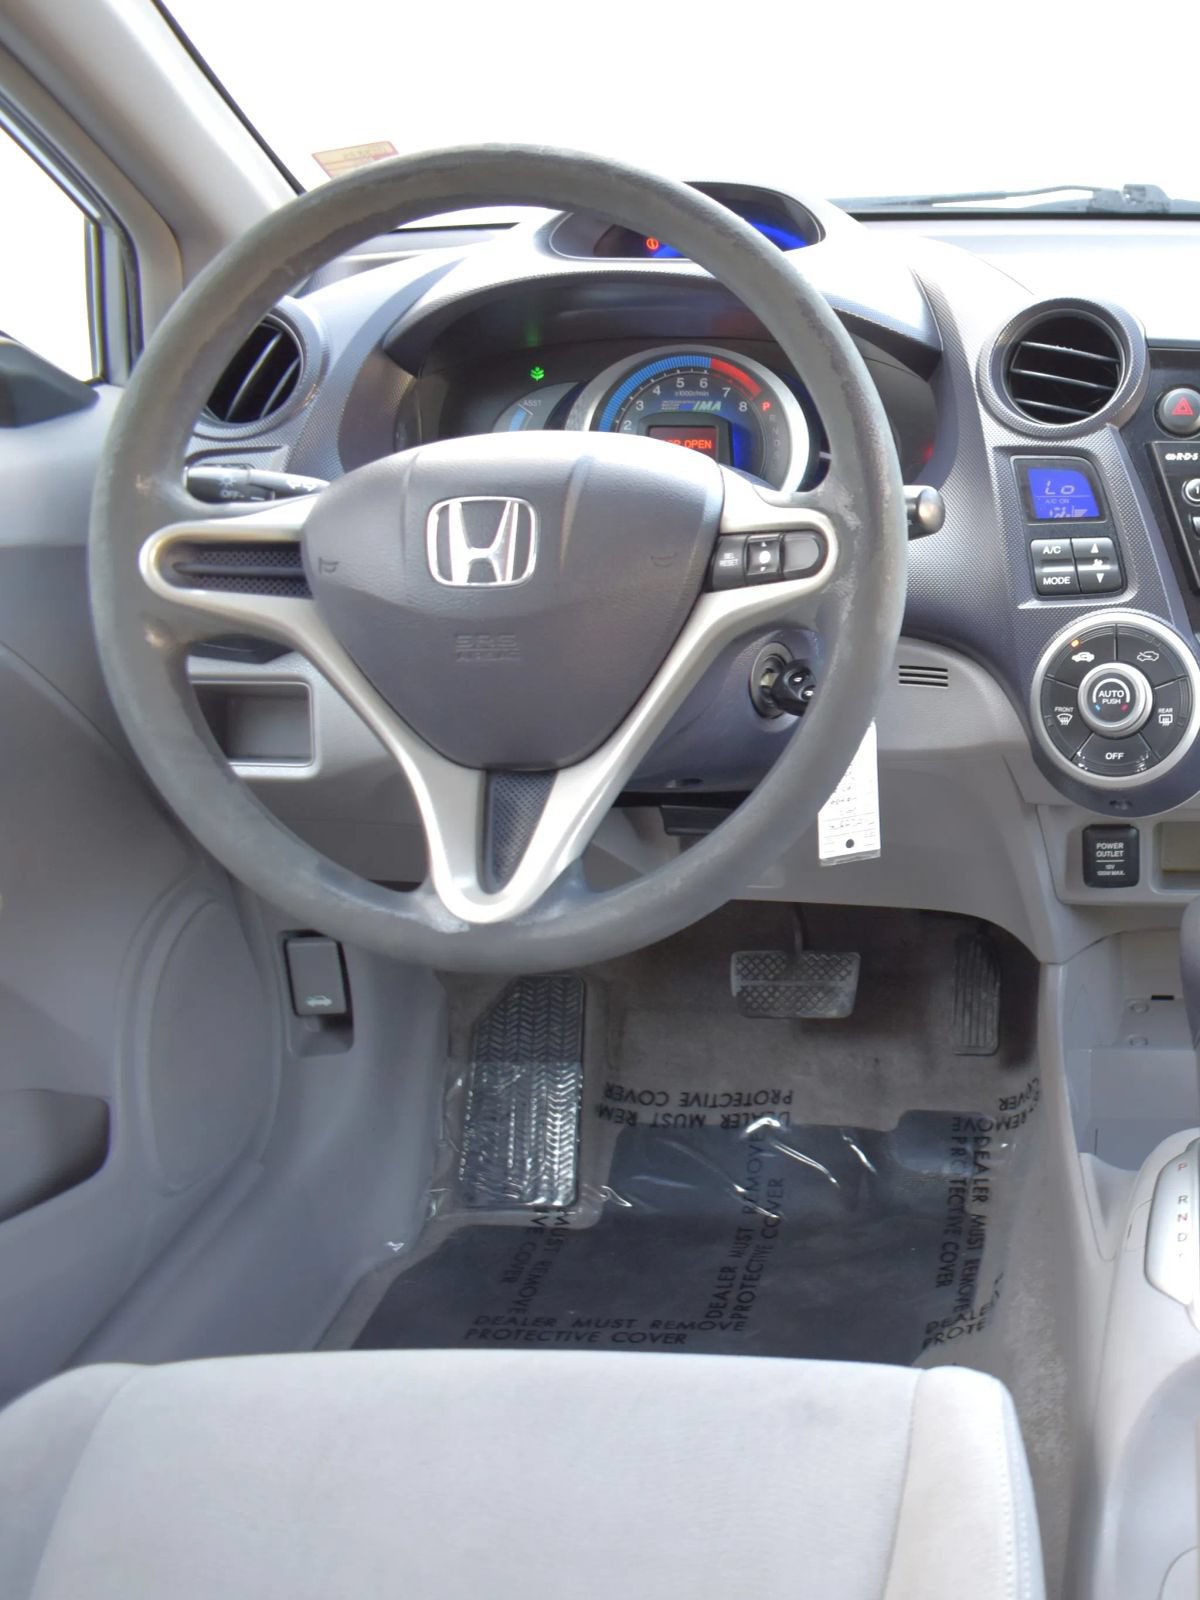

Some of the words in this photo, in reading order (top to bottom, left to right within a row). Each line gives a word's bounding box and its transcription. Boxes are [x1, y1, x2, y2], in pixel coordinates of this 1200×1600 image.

[676, 377, 685, 388] 5
[699, 377, 708, 388] 6
[652, 385, 661, 396] 4
[722, 387, 731, 398] 7
[635, 401, 644, 411] 3
[738, 401, 748, 412] 8
[762, 402, 771, 411] P
[623, 420, 632, 430] 2
[684, 440, 712, 449] OPEN
[1195, 486, 1200, 494] 1
[1043, 546, 1061, 554] A/C
[1043, 576, 1071, 585] MODE
[1098, 690, 1125, 698] AUTO
[1105, 752, 1124, 760] OFF
[603, 1081, 670, 1107] COVER
[679, 1089, 794, 1108] PROTECTIVE
[652, 1111, 706, 1129] MUST
[967, 1214, 987, 1250] MUST
[935, 1241, 959, 1288] COVER
[704, 1266, 739, 1319] DEALER
[728, 1227, 755, 1258] MUST
[728, 1245, 774, 1319] PROTECTIVE
[473, 1315, 557, 1328] DEALER
[571, 1318, 638, 1330] MUST
[651, 1319, 745, 1332] REMOVE
[464, 1328, 600, 1343] PROTECTIVE
[610, 1331, 687, 1345] COVER
